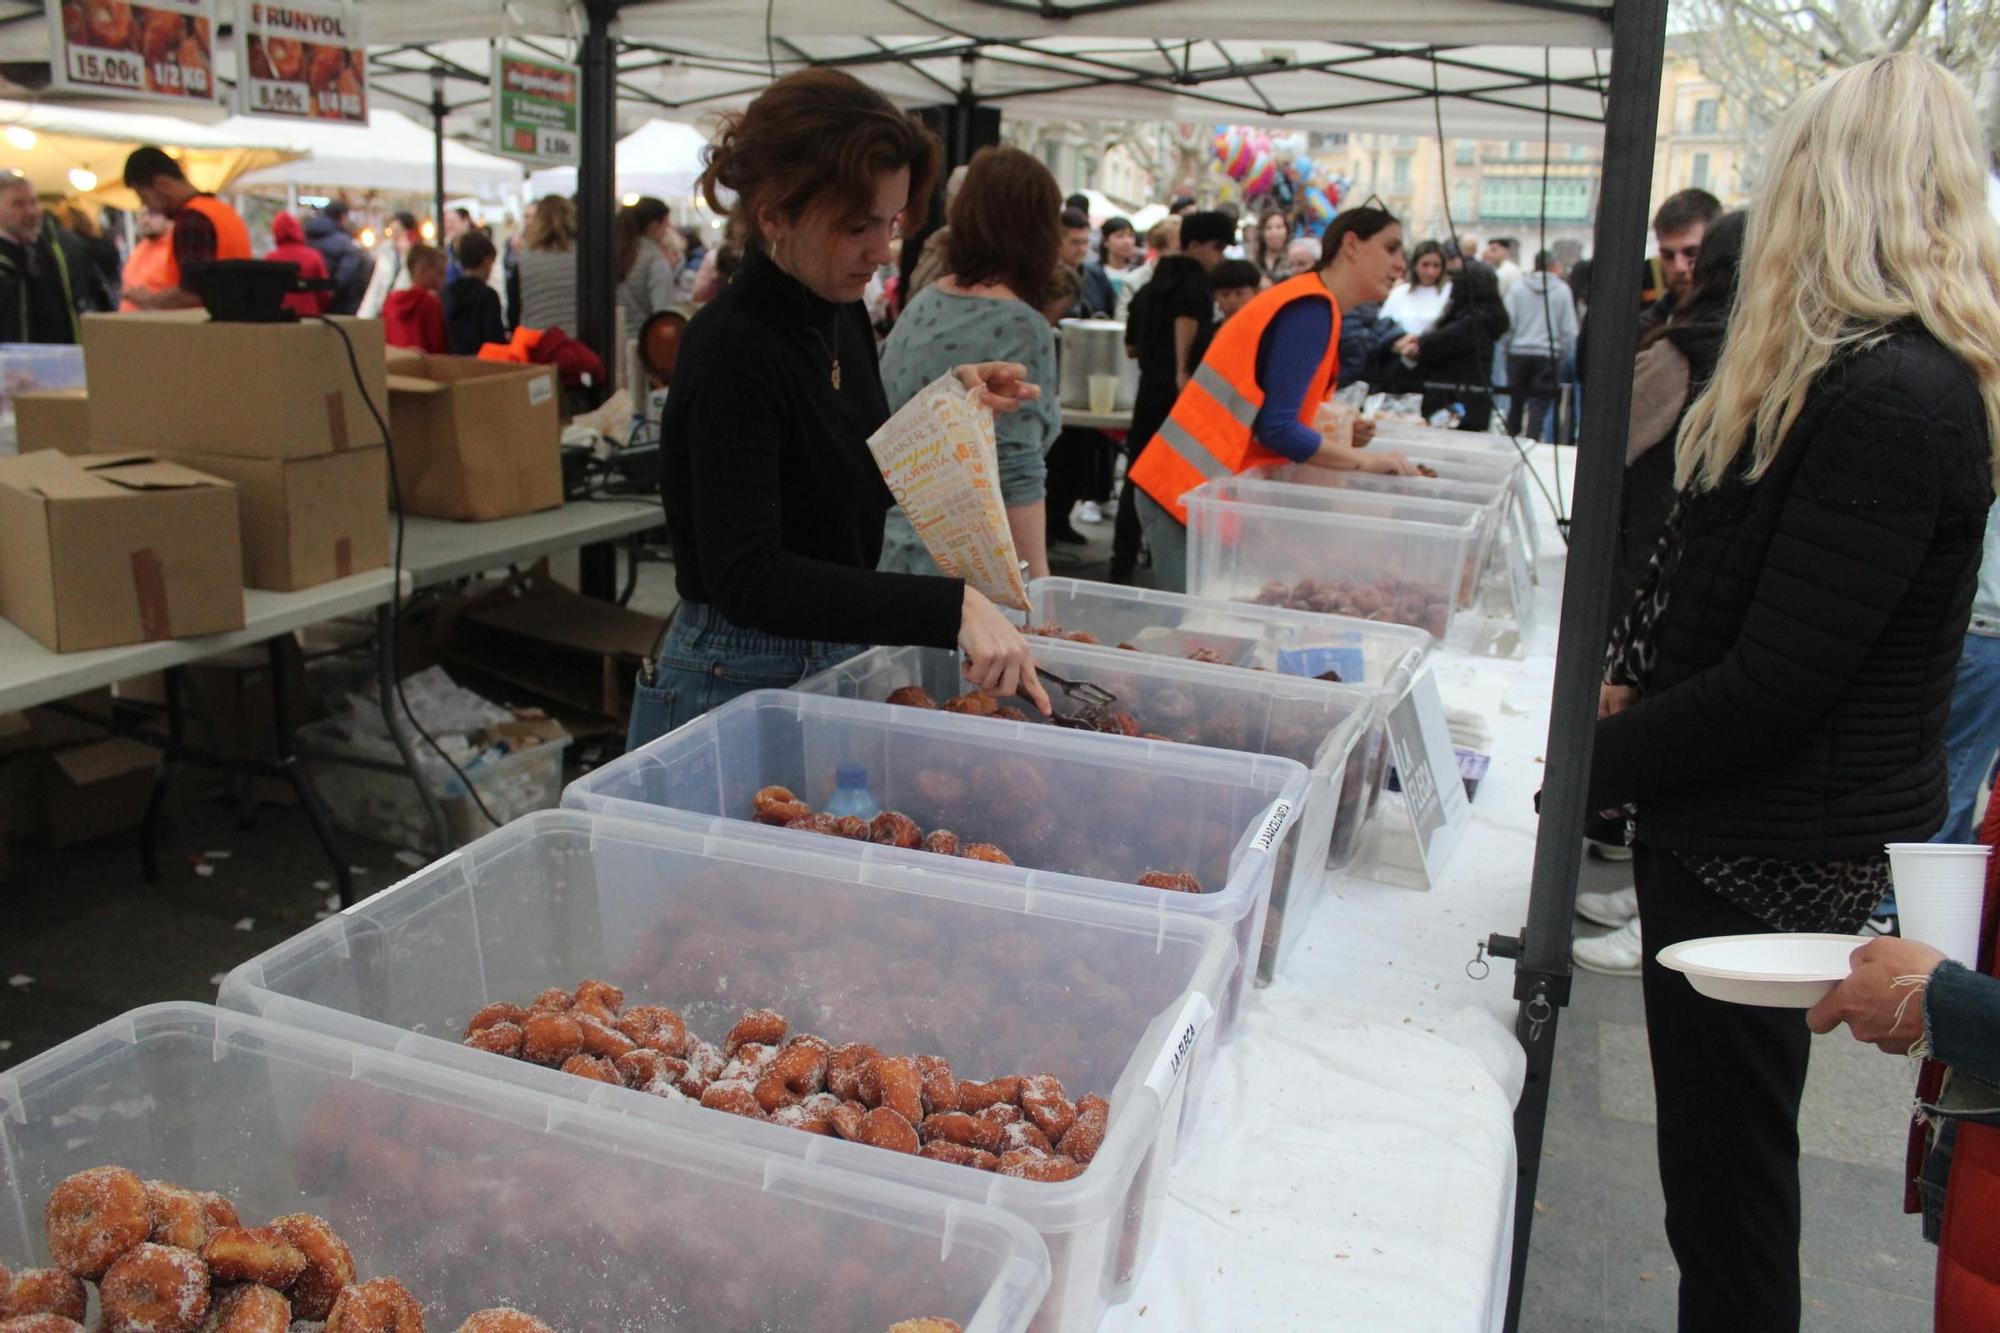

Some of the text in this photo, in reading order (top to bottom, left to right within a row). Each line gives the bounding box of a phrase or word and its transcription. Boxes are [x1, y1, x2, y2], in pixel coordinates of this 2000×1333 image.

[1397, 737, 1414, 775] LA
[1171, 1023, 1196, 1075] LA FLECA
